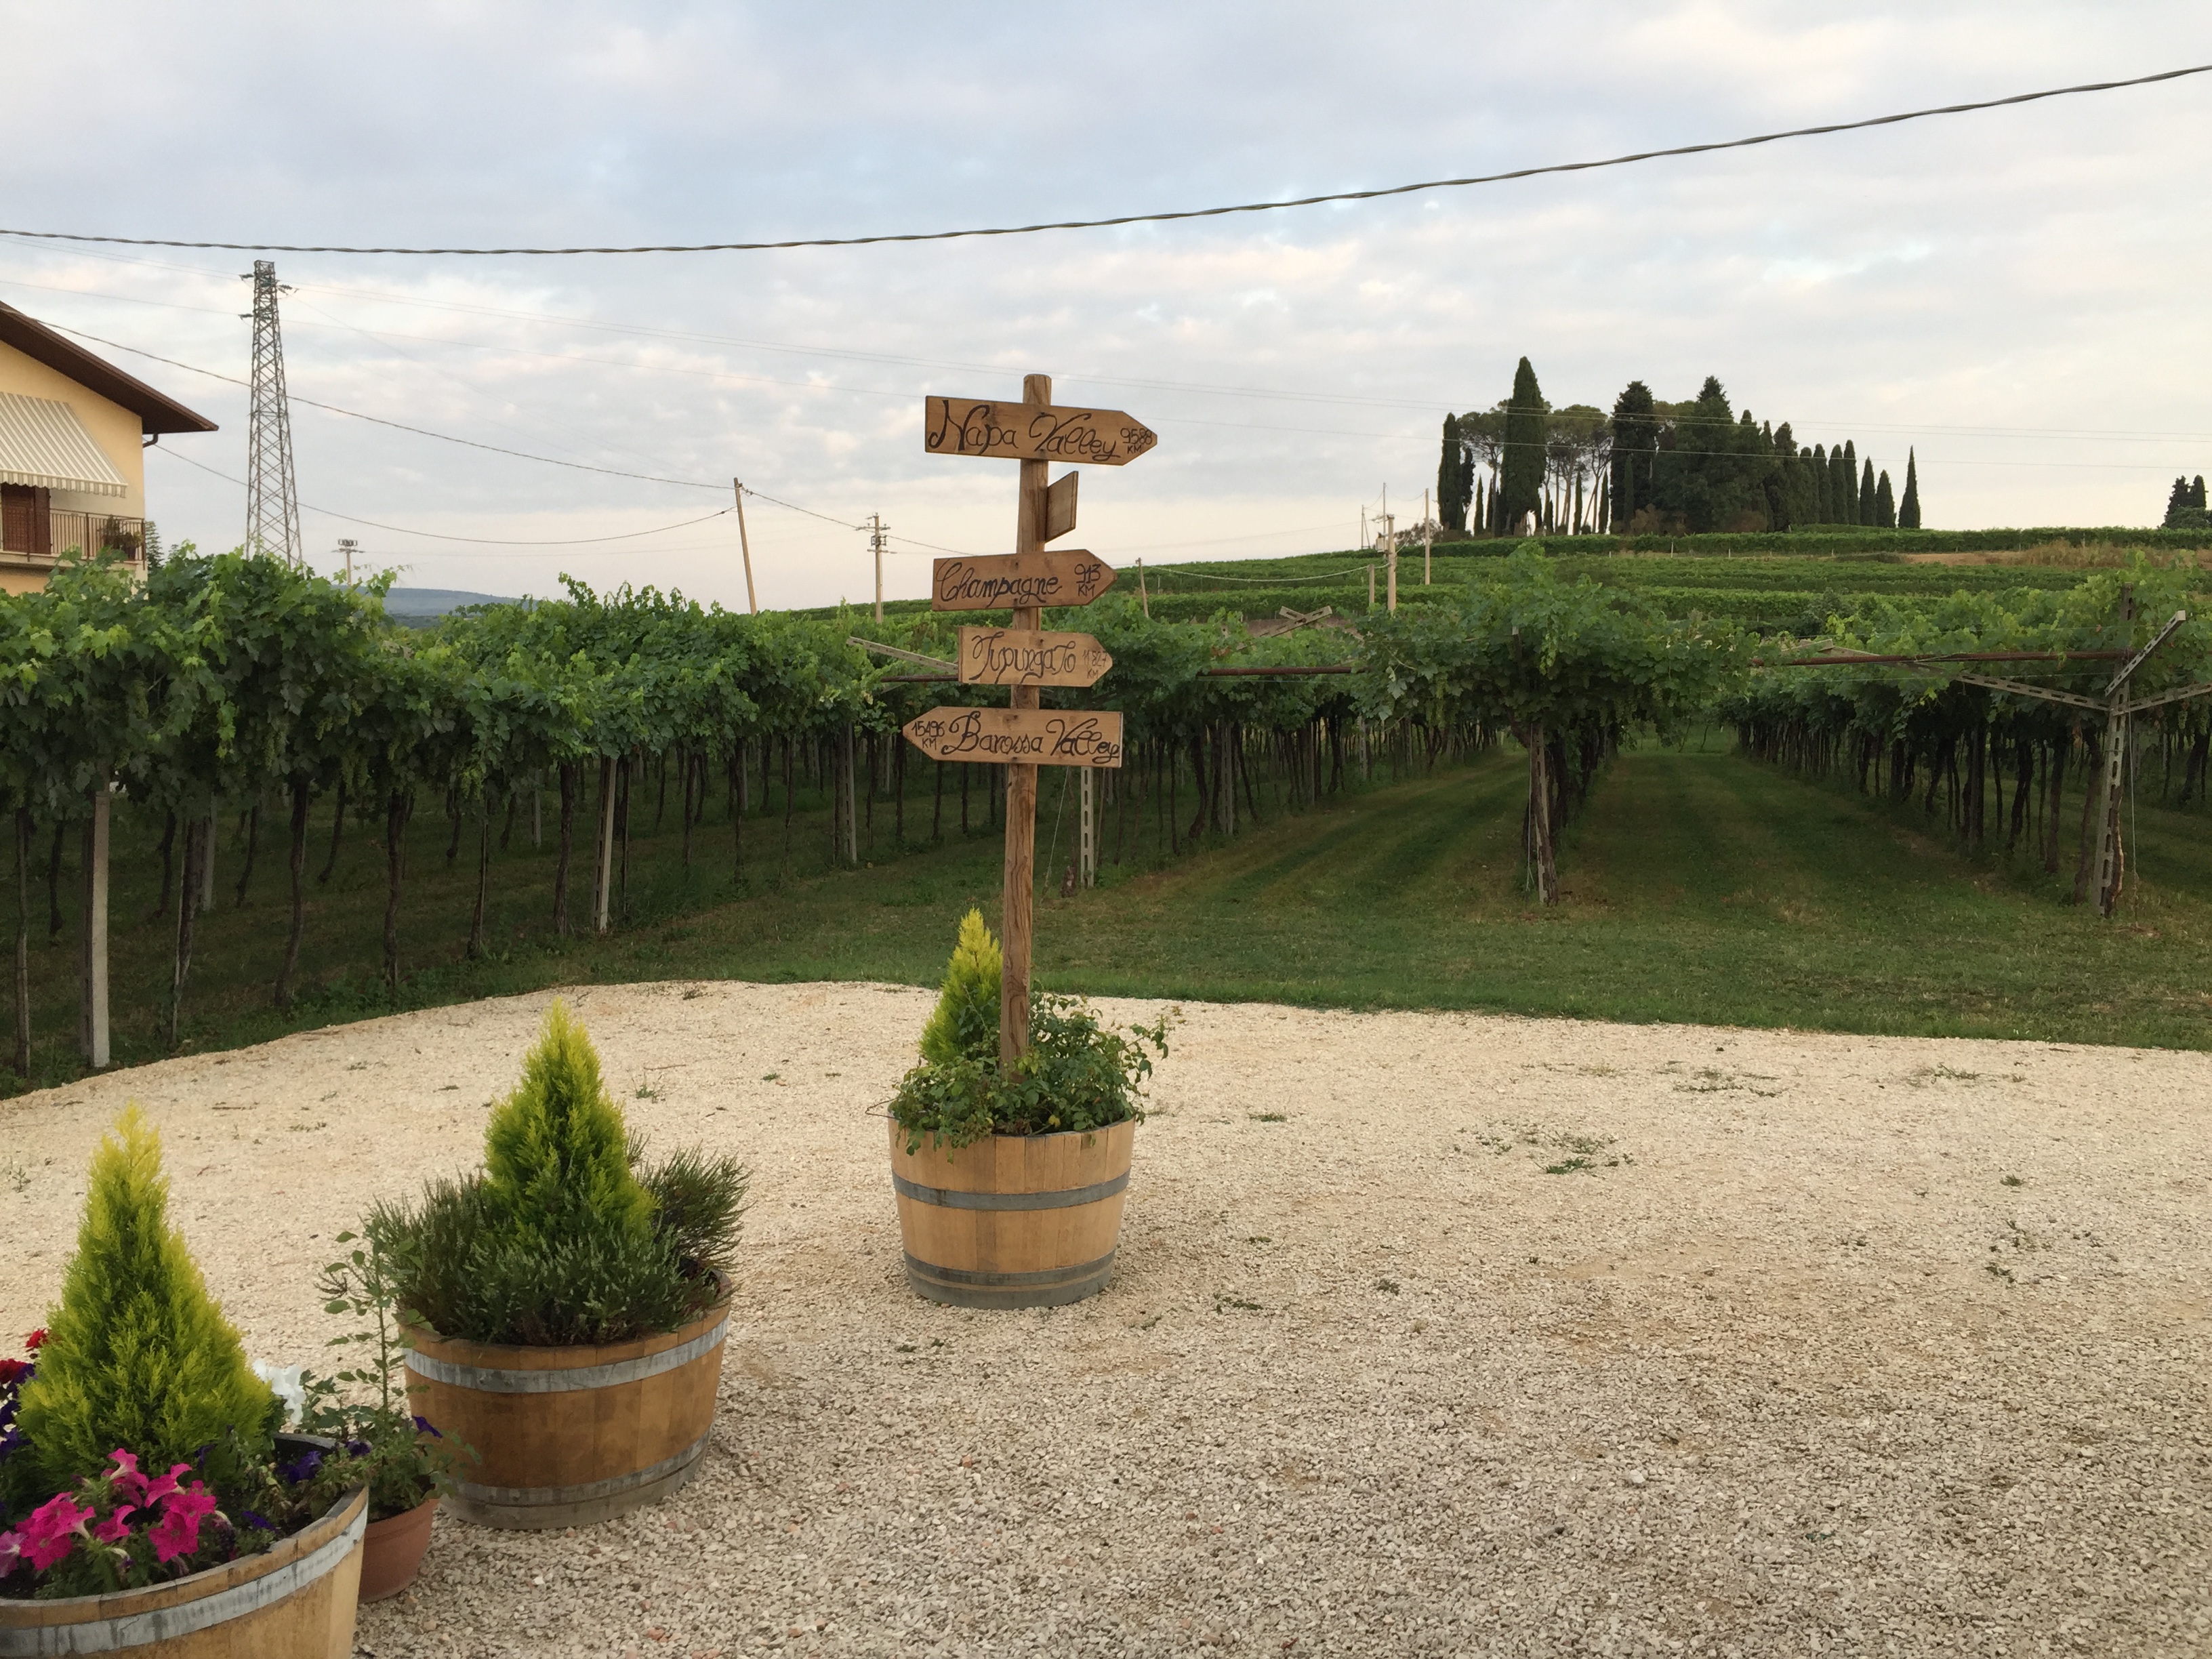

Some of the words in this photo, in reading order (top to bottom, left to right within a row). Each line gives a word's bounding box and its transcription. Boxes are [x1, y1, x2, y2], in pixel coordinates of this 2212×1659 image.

[928, 400, 1019, 455] Napa
[1029, 413, 1120, 462] Valley
[1120, 428, 1152, 445] 9588
[1127, 445, 1142, 454] KM
[1074, 563, 1101, 583] 913
[935, 558, 1063, 608] Champagne
[1078, 583, 1095, 597] KM
[1087, 668, 1099, 679] KM
[922, 737, 937, 750] KM
[941, 710, 1043, 755] Barossa
[1046, 718, 1120, 764] Valley
